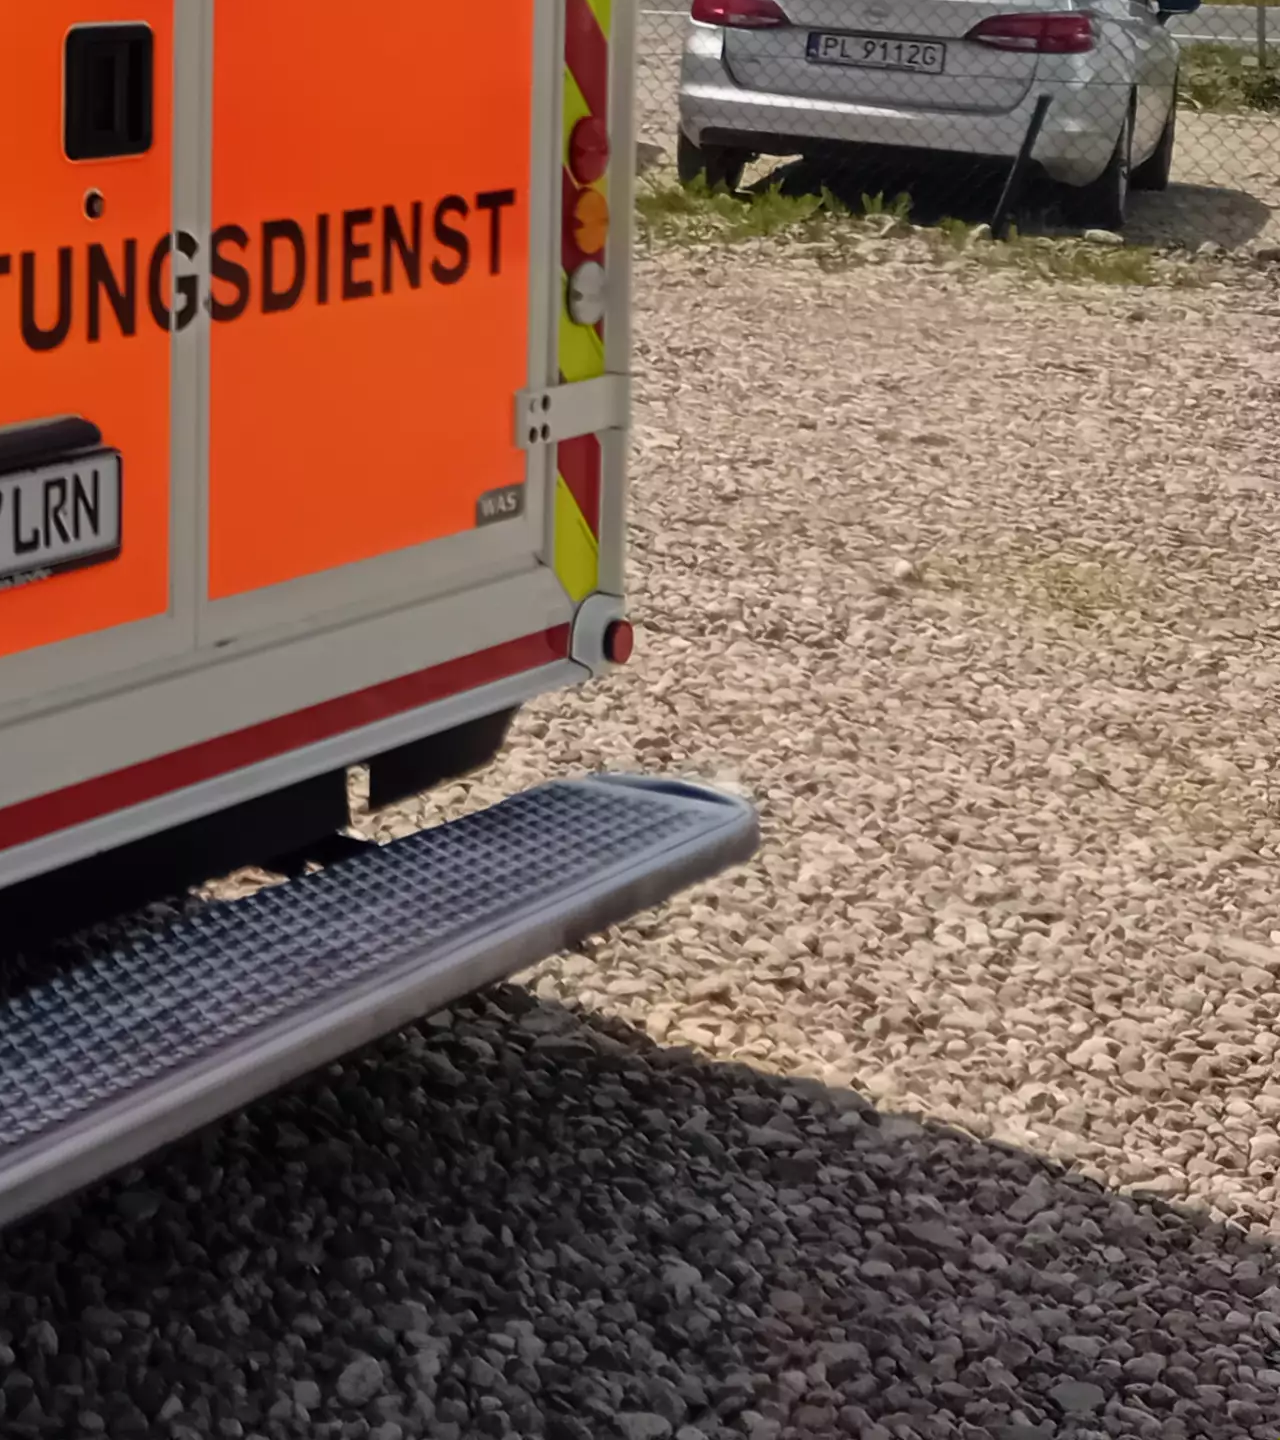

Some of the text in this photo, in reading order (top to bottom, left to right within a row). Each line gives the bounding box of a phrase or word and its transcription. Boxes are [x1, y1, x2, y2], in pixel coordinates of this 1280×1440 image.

[823, 37, 937, 66] PL 9112G
[481, 491, 517, 517] WAS
